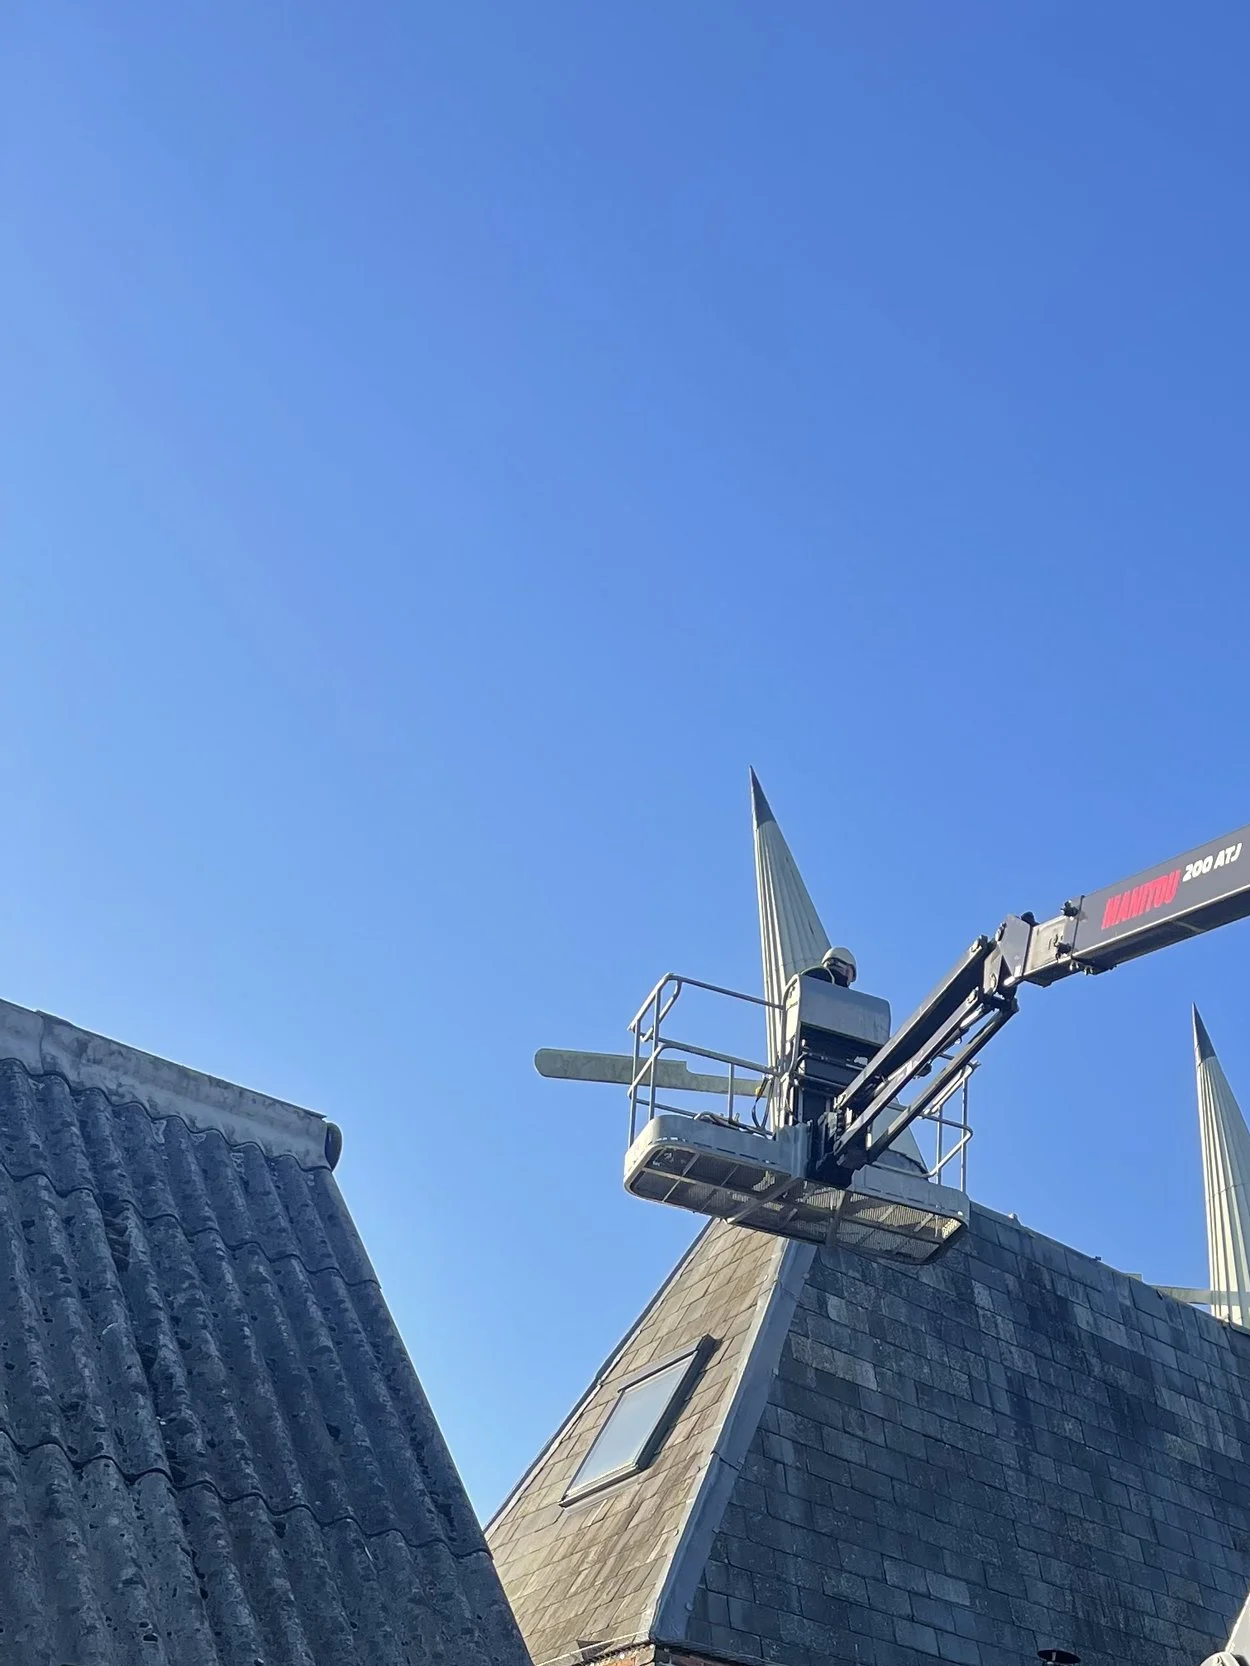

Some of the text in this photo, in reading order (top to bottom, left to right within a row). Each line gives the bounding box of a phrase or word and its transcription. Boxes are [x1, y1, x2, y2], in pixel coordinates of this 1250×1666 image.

[1101, 842, 1243, 929] MANITOU 200 ATJ
